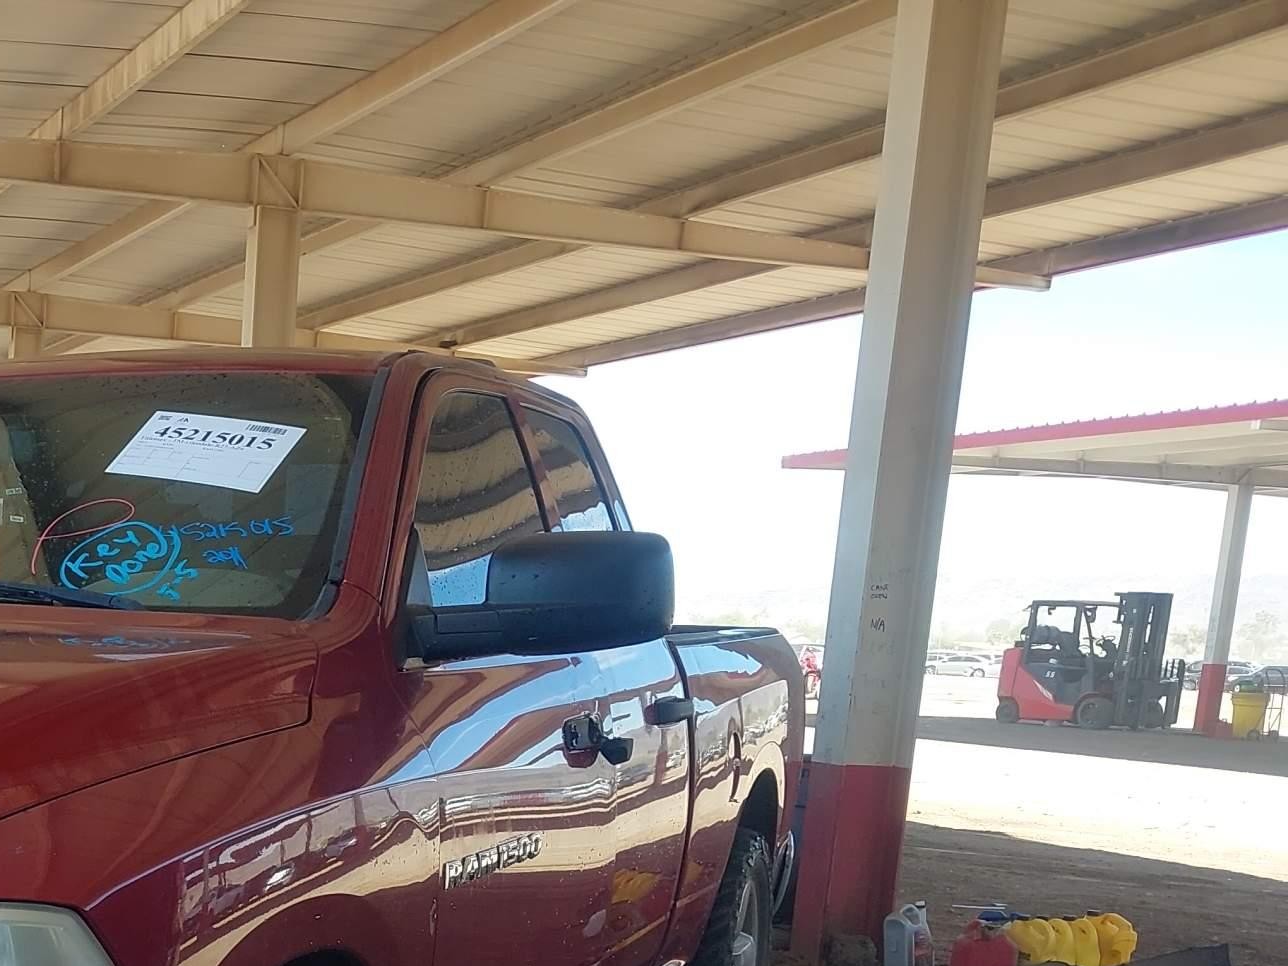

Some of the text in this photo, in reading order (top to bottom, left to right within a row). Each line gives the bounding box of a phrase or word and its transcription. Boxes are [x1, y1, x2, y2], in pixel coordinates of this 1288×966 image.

[154, 426, 276, 450] 45215015
[870, 617, 886, 633] N/A
[444, 831, 545, 889] RAM 1500
